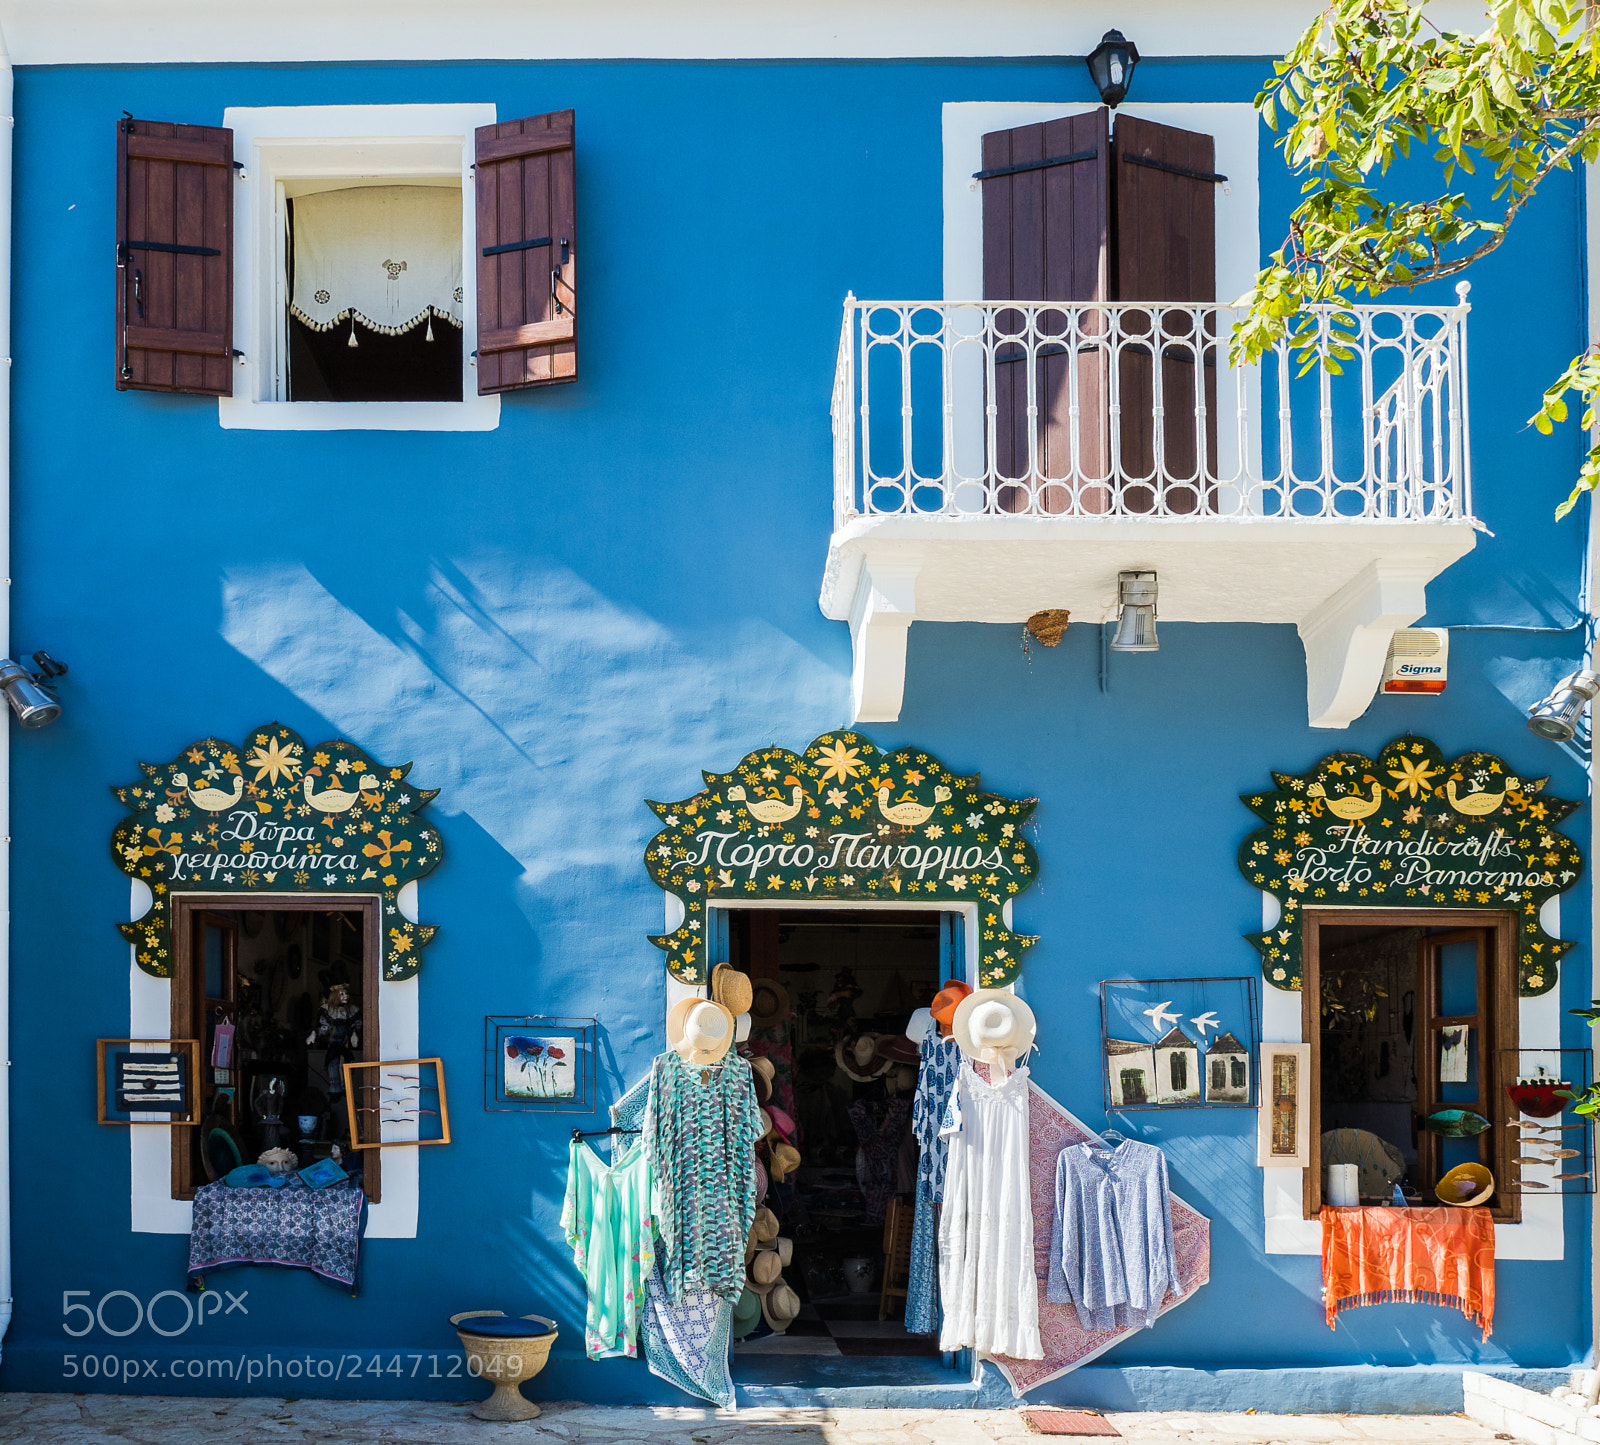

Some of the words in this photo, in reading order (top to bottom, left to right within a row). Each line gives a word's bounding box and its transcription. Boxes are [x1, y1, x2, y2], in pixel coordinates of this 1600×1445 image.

[1400, 664, 1442, 675] Sigma
[671, 830, 814, 879] Πόρτο
[811, 832, 1014, 880] Πάνορμος
[1326, 825, 1521, 866] Handicrafts
[1283, 847, 1372, 884] Porto
[1390, 855, 1561, 887] Panormos
